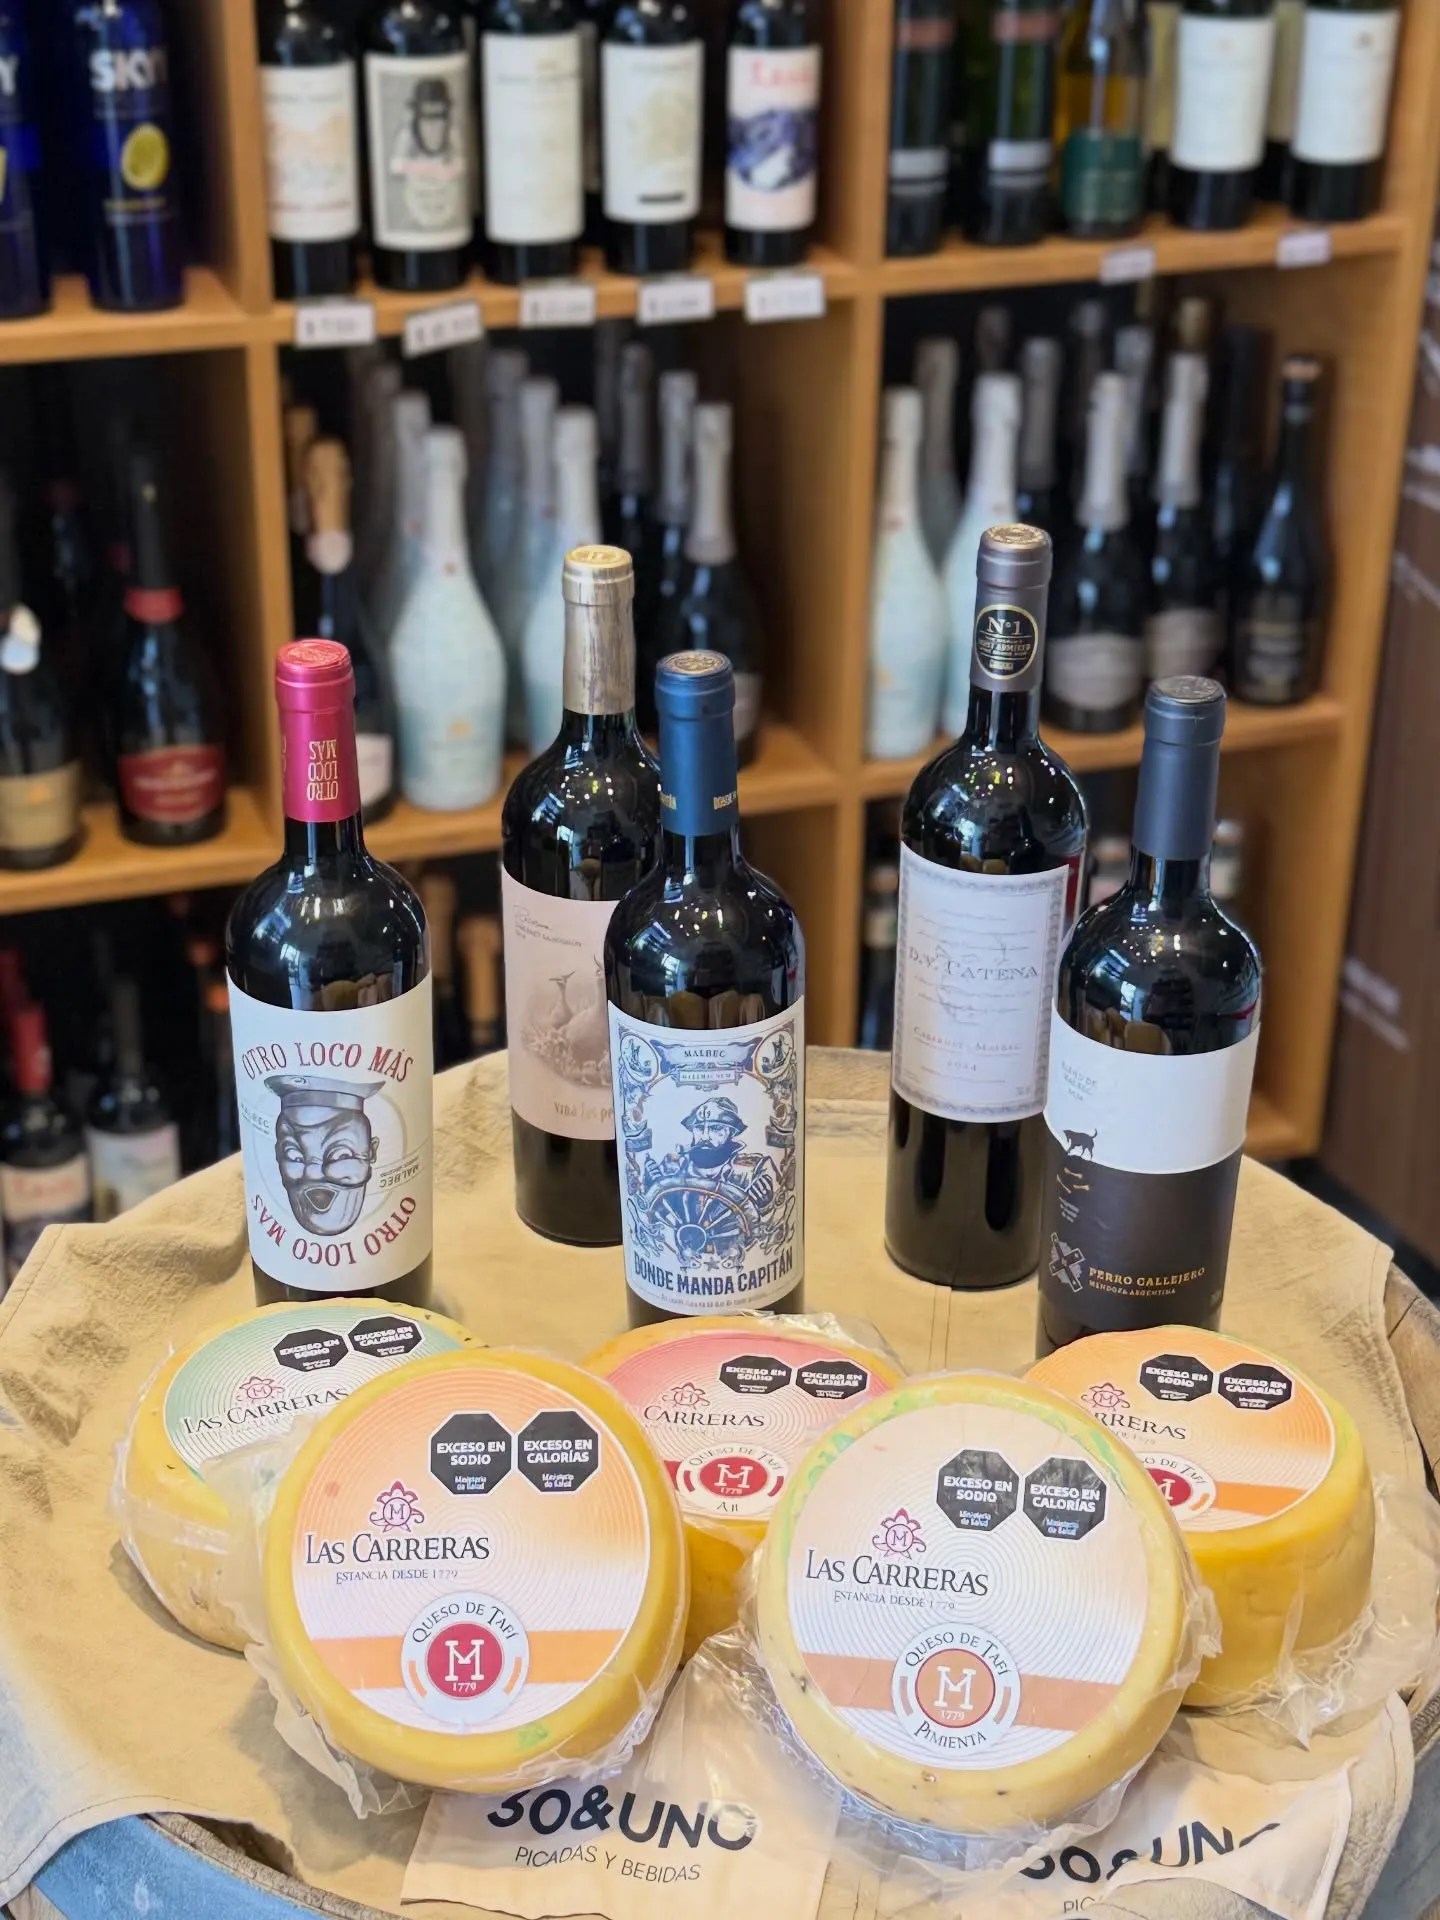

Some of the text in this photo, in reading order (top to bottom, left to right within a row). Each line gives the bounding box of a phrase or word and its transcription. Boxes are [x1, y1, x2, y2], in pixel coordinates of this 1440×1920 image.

[308, 761, 338, 781] LOCO
[306, 781, 339, 801] OTRO
[947, 959, 1039, 980] CATENA
[242, 1043, 287, 1080] OTRO
[294, 1042, 362, 1068] LOCO
[684, 1049, 727, 1058] MALBEC
[364, 1197, 416, 1256] OTRO
[292, 1239, 356, 1267] LOCO
[634, 1251, 674, 1291] DONDE
[677, 1273, 734, 1296] MANDA
[1089, 1266, 1205, 1287] PERRO CALLEJERO
[182, 1416, 222, 1434] LAS
[227, 1388, 350, 1425] CARRERAS
[644, 1405, 766, 1427] CARRERAS
[1094, 1412, 1187, 1440] RRERAS
[437, 1441, 506, 1454] EXCESO EN
[523, 1439, 593, 1451] EXCESO EN
[450, 1454, 492, 1466] SODIO
[526, 1450, 590, 1464] CALORÍAS
[714, 1463, 754, 1489] M
[943, 1475, 1013, 1492] EXCESO EN
[956, 1489, 998, 1503] SODIO
[1030, 1483, 1100, 1501] EXCESO EN
[1032, 1496, 1096, 1513] CALORÍAS
[306, 1533, 490, 1564] LAS CARRERAS
[336, 1570, 388, 1585] ESTANCIA
[392, 1569, 429, 1580] DESDE
[805, 1549, 989, 1596] LAS CARRERAS
[834, 1590, 886, 1604] ESTANCIA
[889, 1595, 925, 1608] DESDE
[412, 1603, 460, 1643] QUESO
[465, 1601, 486, 1616] DE
[905, 1631, 955, 1667] QUESO
[959, 1632, 981, 1648] DE
[444, 1639, 485, 1682] M
[933, 1665, 977, 1710] M
[914, 1720, 987, 1750] PIMIENTA
[515, 1844, 701, 1884] PICADAS Y BEBIDAS
